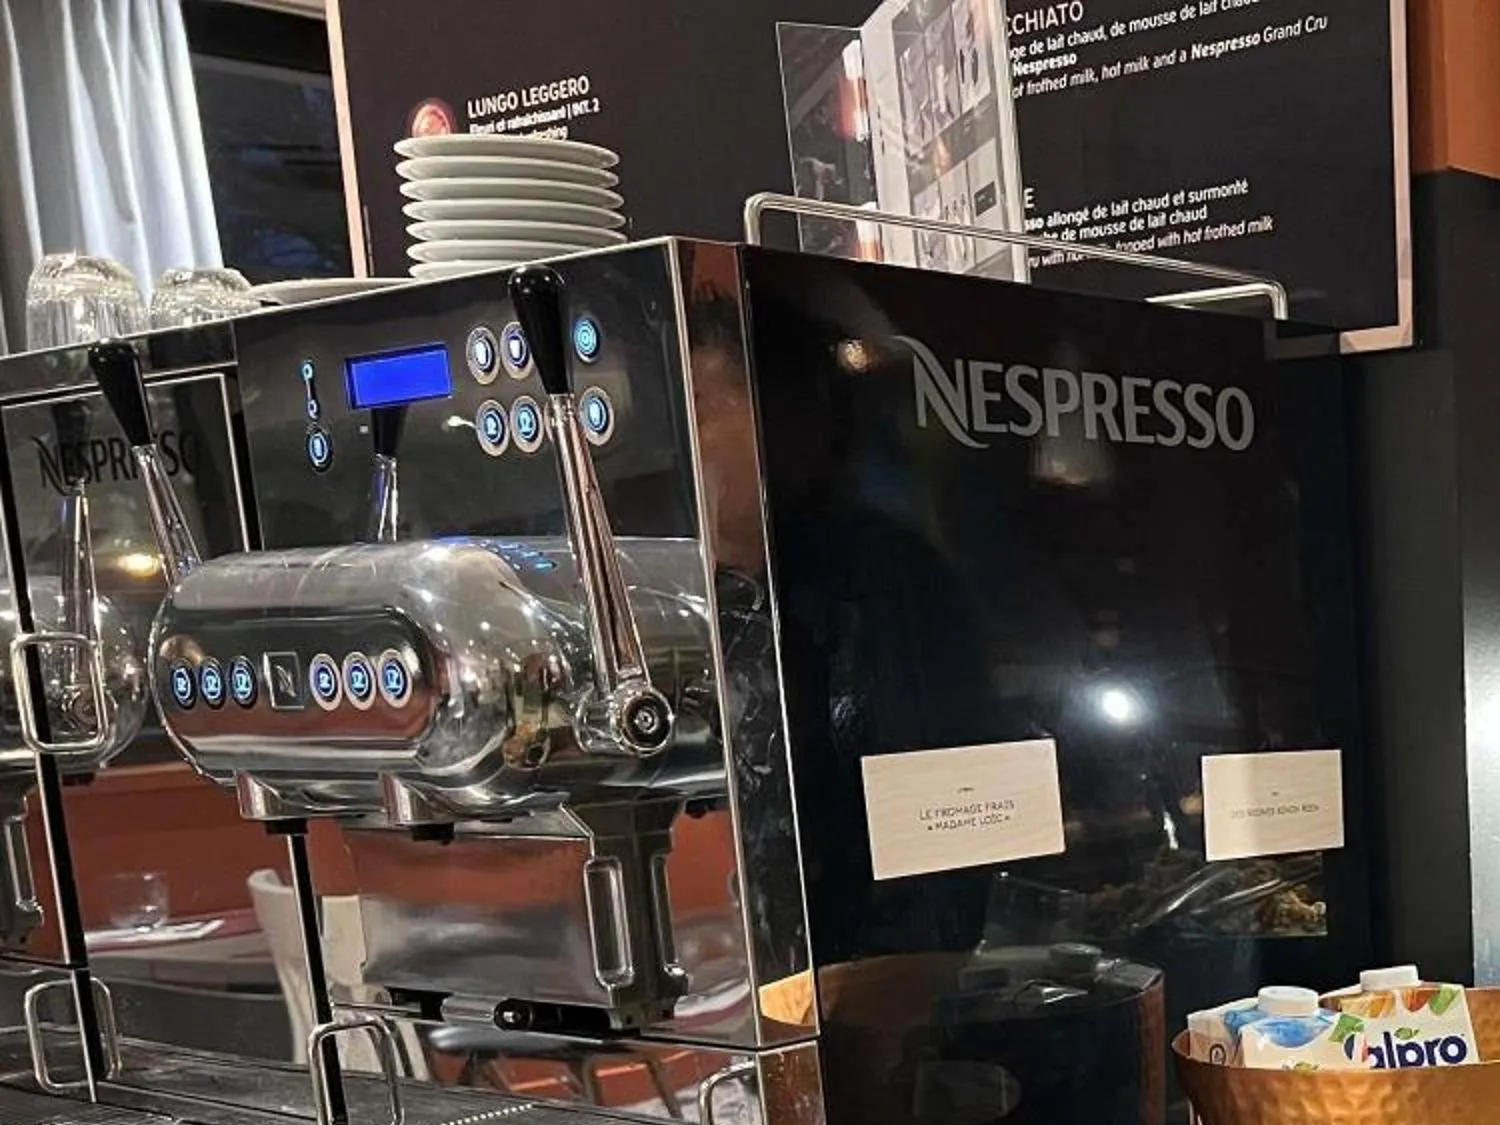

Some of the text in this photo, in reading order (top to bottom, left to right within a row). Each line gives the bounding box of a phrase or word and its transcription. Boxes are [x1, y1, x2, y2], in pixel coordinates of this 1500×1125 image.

[1029, 40, 1045, 55] de
[1047, 34, 1065, 50] lait
[1110, 22, 1127, 37] de
[1129, 11, 1178, 33] mousse
[1179, 4, 1197, 21] de
[1013, 52, 1078, 77] Nespresso
[1026, 74, 1067, 96] frothed
[1101, 61, 1122, 80] hot
[1123, 56, 1149, 75] milk
[1152, 50, 1176, 69] and
[1179, 50, 1187, 63] a
[1190, 32, 1261, 60] Nespresso
[1263, 20, 1302, 43] Grand
[1304, 15, 1329, 33] Cru
[467, 75, 590, 119] LUNGO LEGGERO
[1092, 204, 1108, 220] de
[1111, 200, 1129, 216] lait
[1131, 193, 1169, 213] chaud
[1187, 178, 1249, 204] surmonté
[1061, 228, 1077, 241] de
[1079, 220, 1126, 240] mousse
[1128, 216, 1145, 232] de
[1147, 211, 1167, 229] lait
[1169, 204, 1208, 225] chaud
[1157, 231, 1181, 248] with
[1183, 228, 1202, 244] hot
[1204, 220, 1245, 241] frothed
[893, 334, 1255, 451] NESPRESSO
[31, 432, 199, 497] NESPRSO
[1366, 1031, 1468, 1069] alpro
